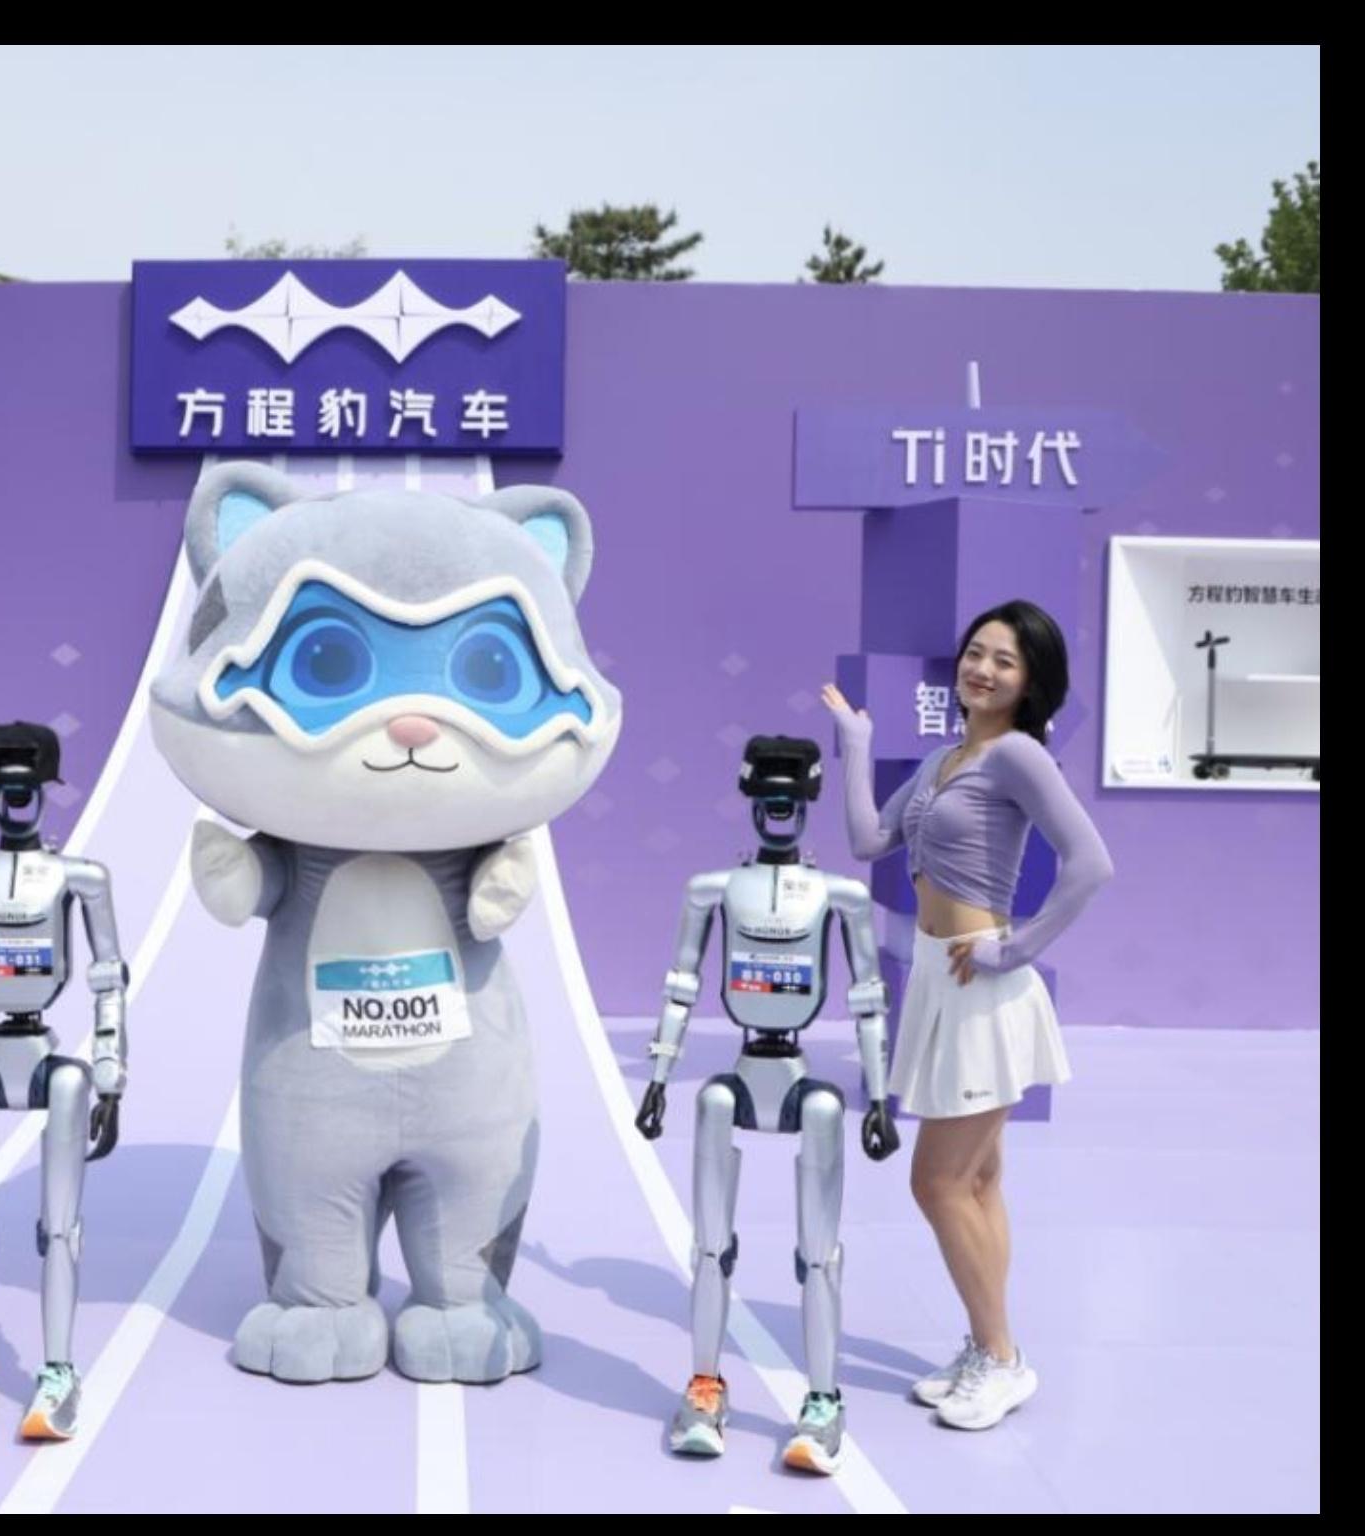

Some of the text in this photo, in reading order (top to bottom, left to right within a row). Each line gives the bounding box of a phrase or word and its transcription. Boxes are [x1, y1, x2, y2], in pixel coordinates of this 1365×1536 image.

[176, 387, 510, 439] 方程豹汽车
[891, 427, 1082, 487] Ti 时代
[342, 993, 440, 1021] NO.001
[341, 1020, 443, 1039] MARATHON
